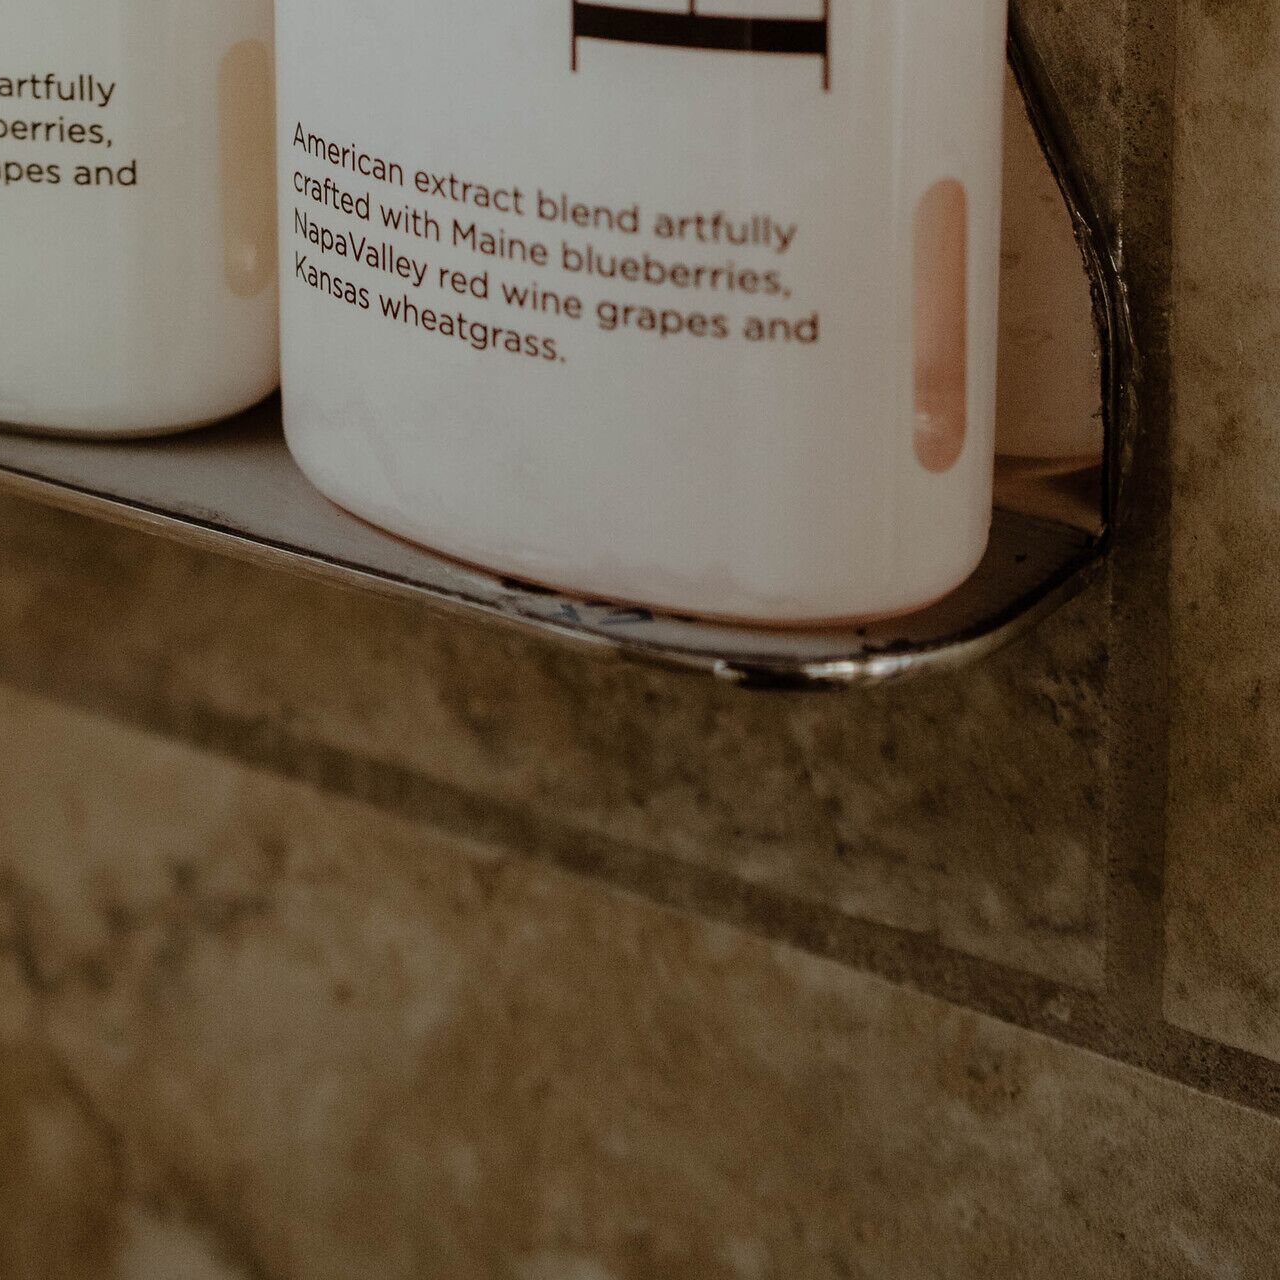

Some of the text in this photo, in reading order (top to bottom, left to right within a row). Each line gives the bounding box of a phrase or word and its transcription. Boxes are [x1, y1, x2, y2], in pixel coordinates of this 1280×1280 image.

[74, 160, 137, 186] and
[293, 121, 797, 253] American extract blend artfully
[293, 168, 791, 298] crafted with Maine blueberries,
[294, 207, 820, 344] NapaValley red wine grapes and
[295, 251, 566, 363] Kansas wheatgrass.
